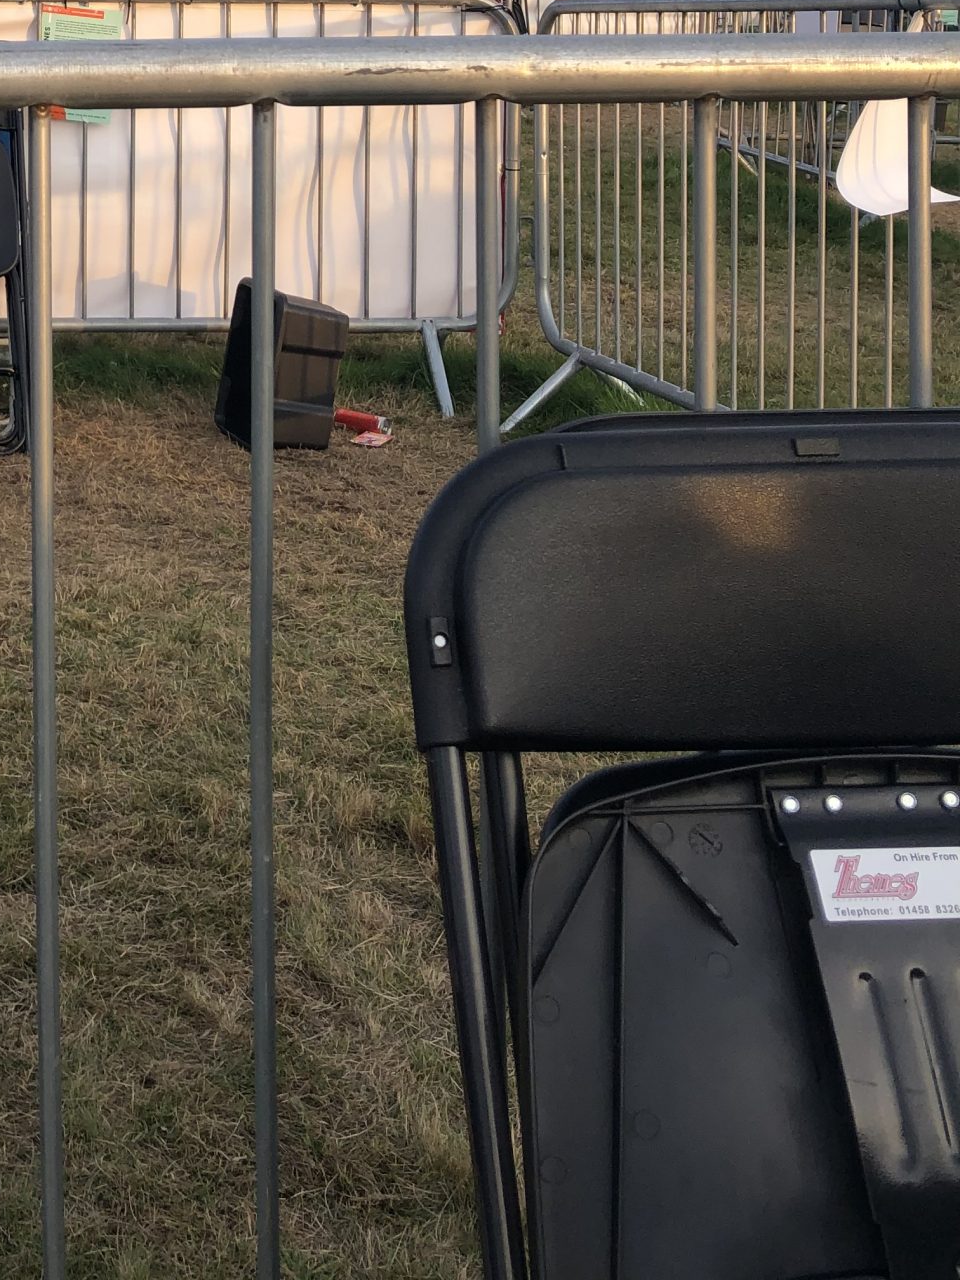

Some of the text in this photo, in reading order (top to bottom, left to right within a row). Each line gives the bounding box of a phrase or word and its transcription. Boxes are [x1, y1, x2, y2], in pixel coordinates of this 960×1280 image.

[893, 852, 959, 862] On Hire From
[834, 906, 893, 918] Telephone:
[898, 905, 931, 915] 01458
